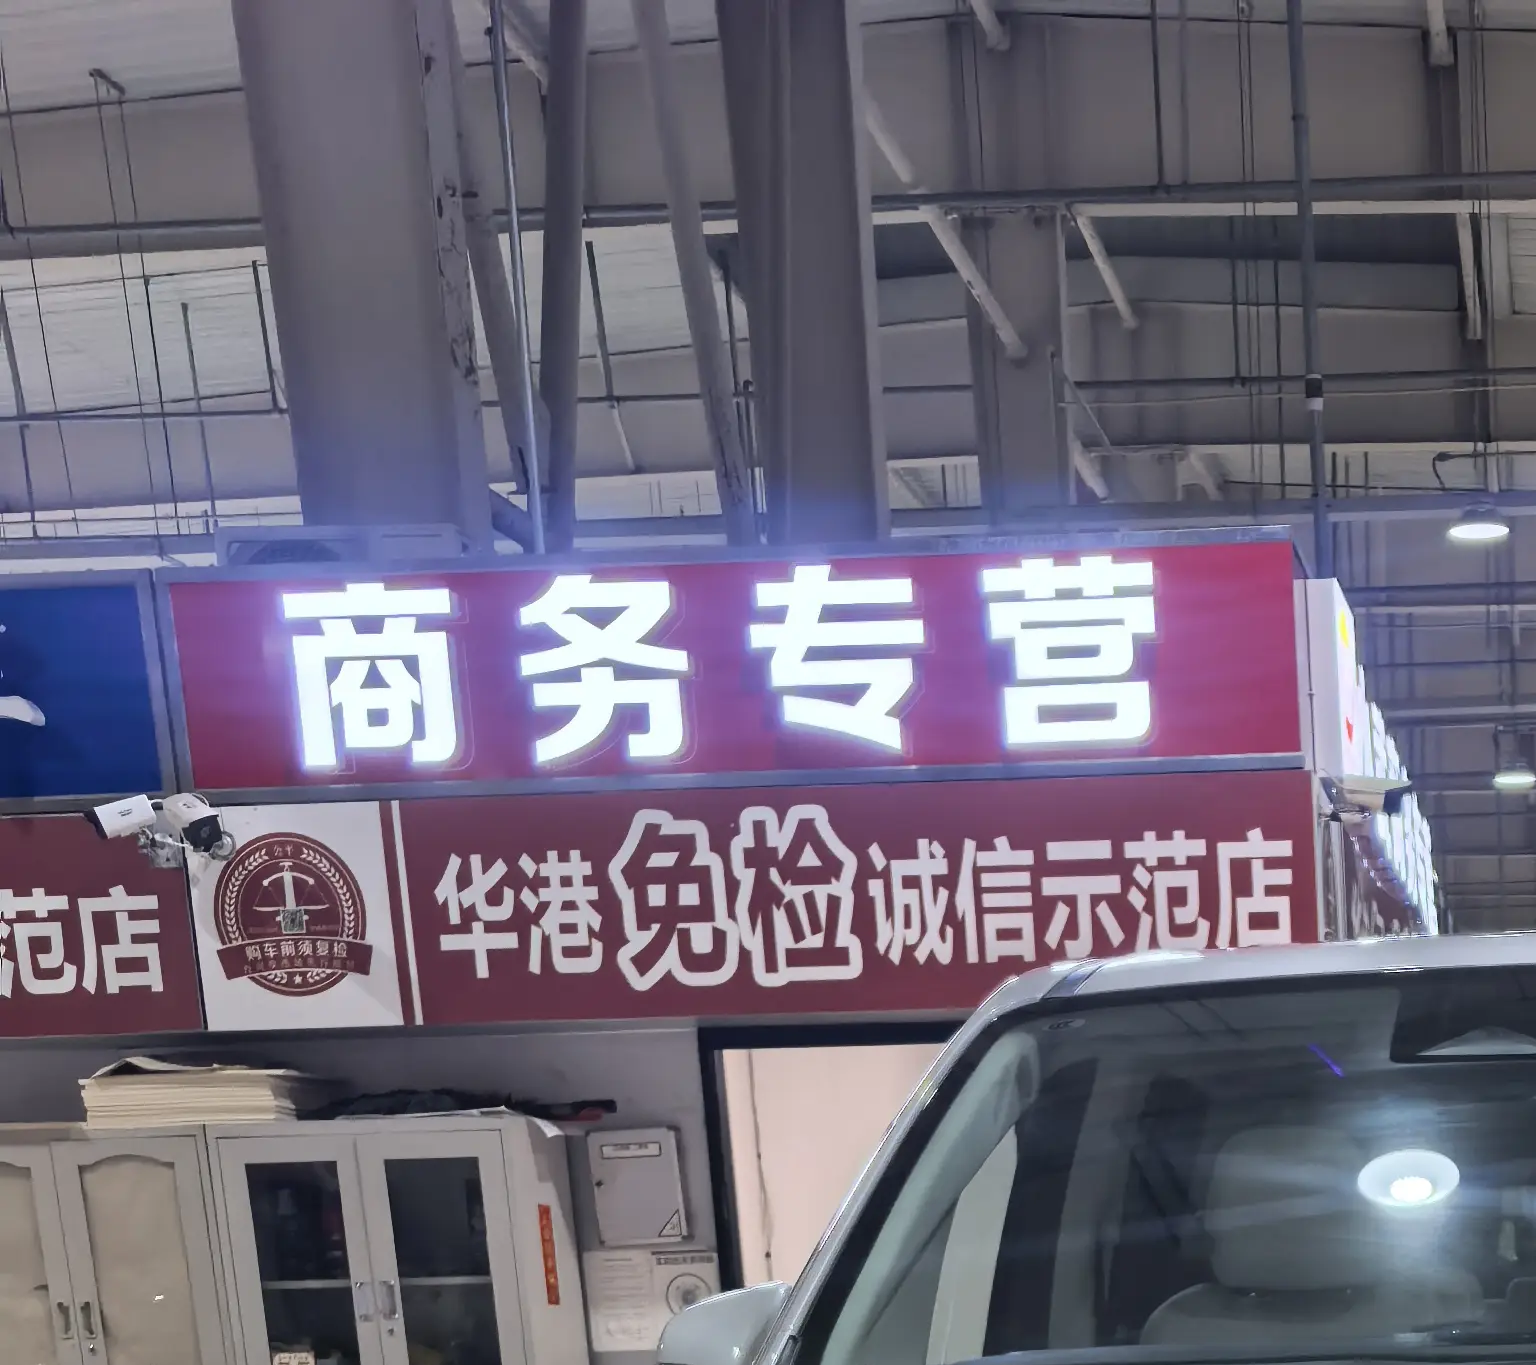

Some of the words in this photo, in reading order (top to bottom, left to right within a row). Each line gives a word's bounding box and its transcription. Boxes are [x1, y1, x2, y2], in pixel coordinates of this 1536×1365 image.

[282, 555, 1156, 767] 商务专营
[0, 885, 163, 998] 范店
[435, 804, 1293, 991] 华港免检诚信示范店
